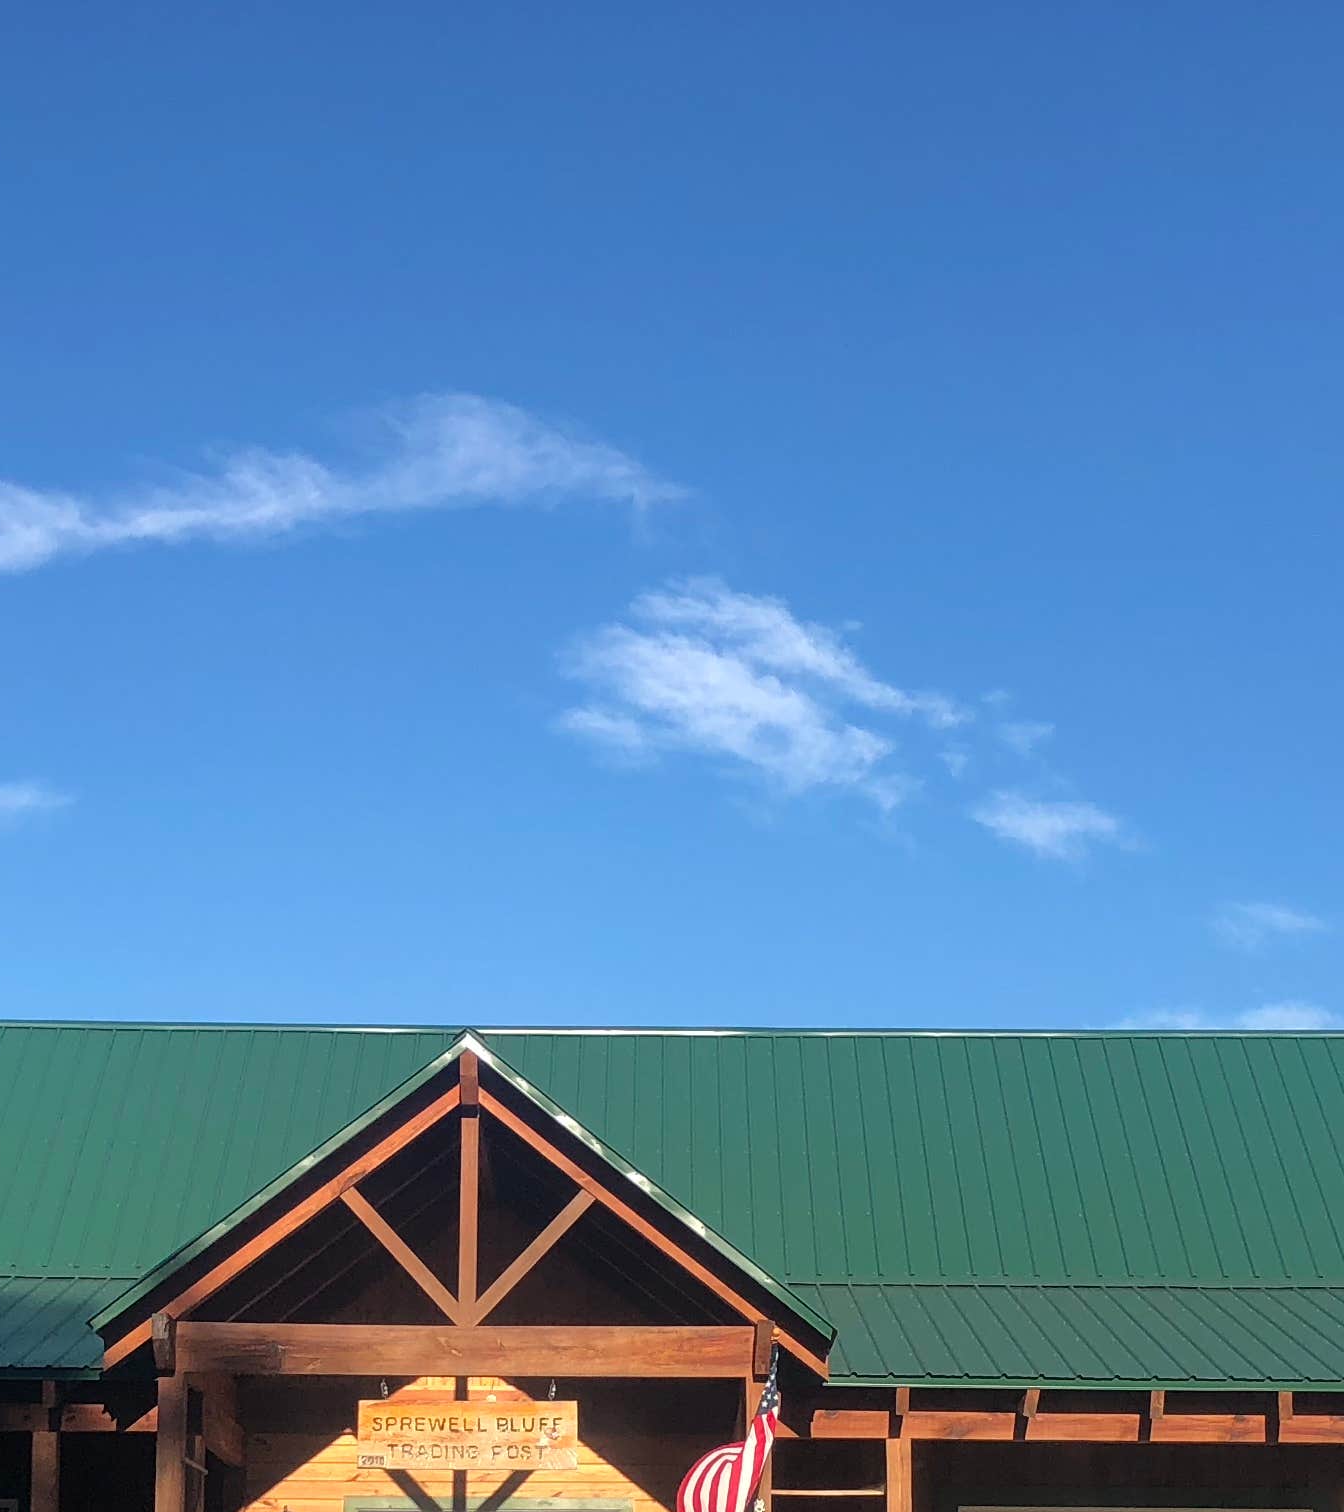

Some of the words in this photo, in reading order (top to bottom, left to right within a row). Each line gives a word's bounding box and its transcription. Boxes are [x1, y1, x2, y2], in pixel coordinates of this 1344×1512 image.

[372, 1417, 487, 1432] SPREWELL
[497, 1417, 563, 1432] BLUFF
[387, 1444, 480, 1460] TRADING
[492, 1445, 548, 1460] POST
